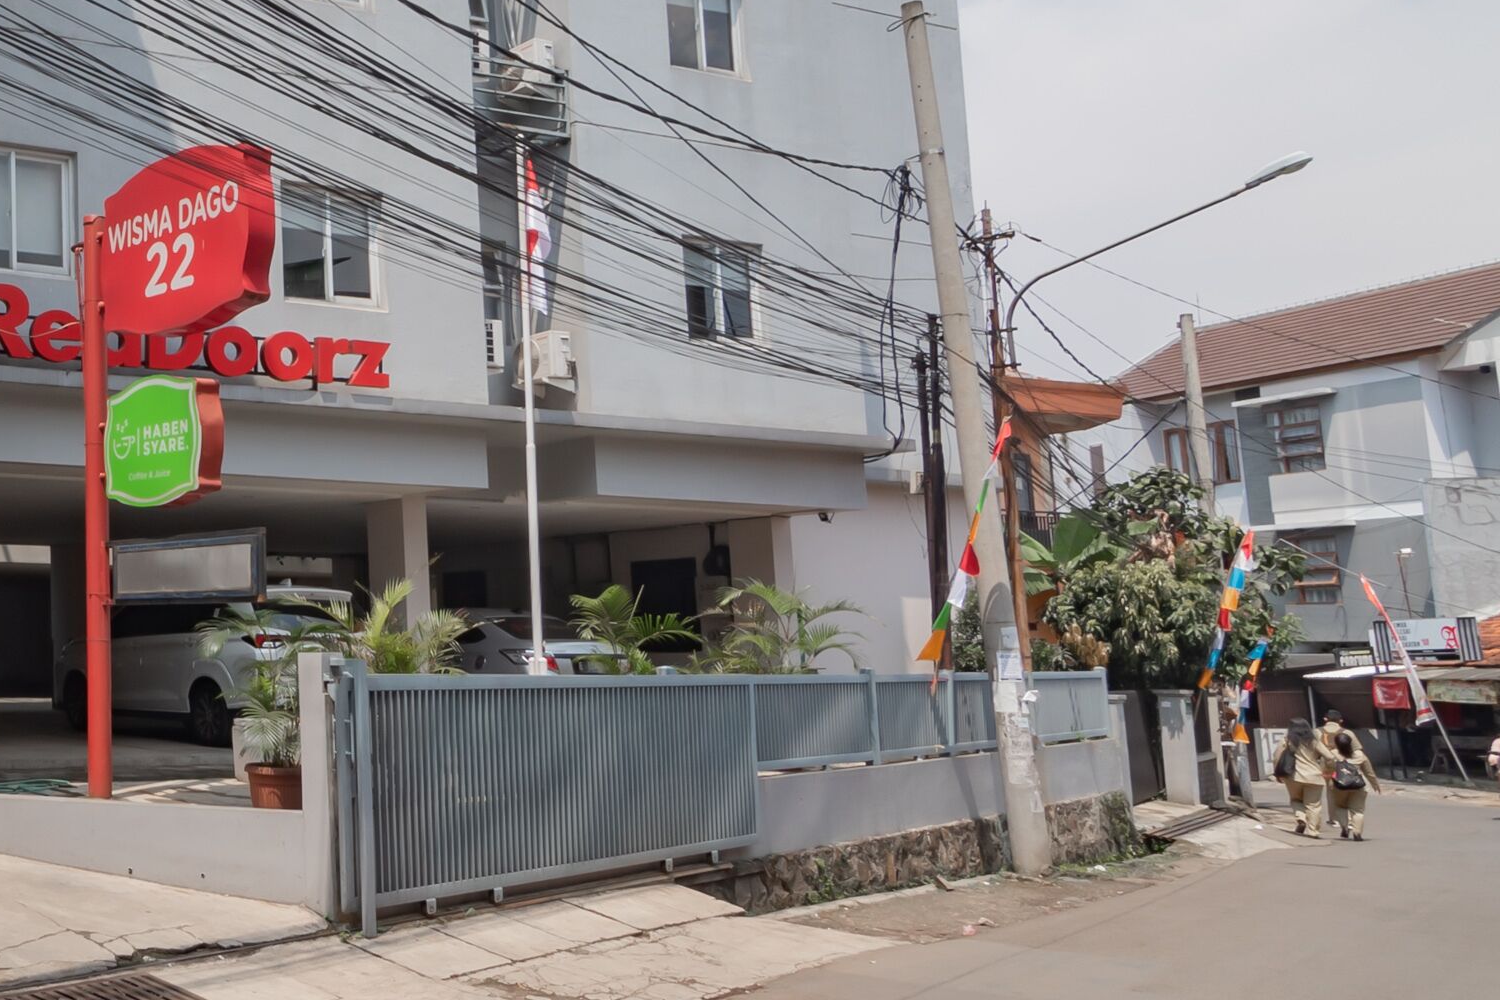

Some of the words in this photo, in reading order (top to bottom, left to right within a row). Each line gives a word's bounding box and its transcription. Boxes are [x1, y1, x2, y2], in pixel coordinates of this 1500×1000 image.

[108, 205, 172, 254] WISMA
[179, 180, 239, 230] DAGO
[145, 232, 195, 297] 22
[143, 419, 188, 440] HABEN
